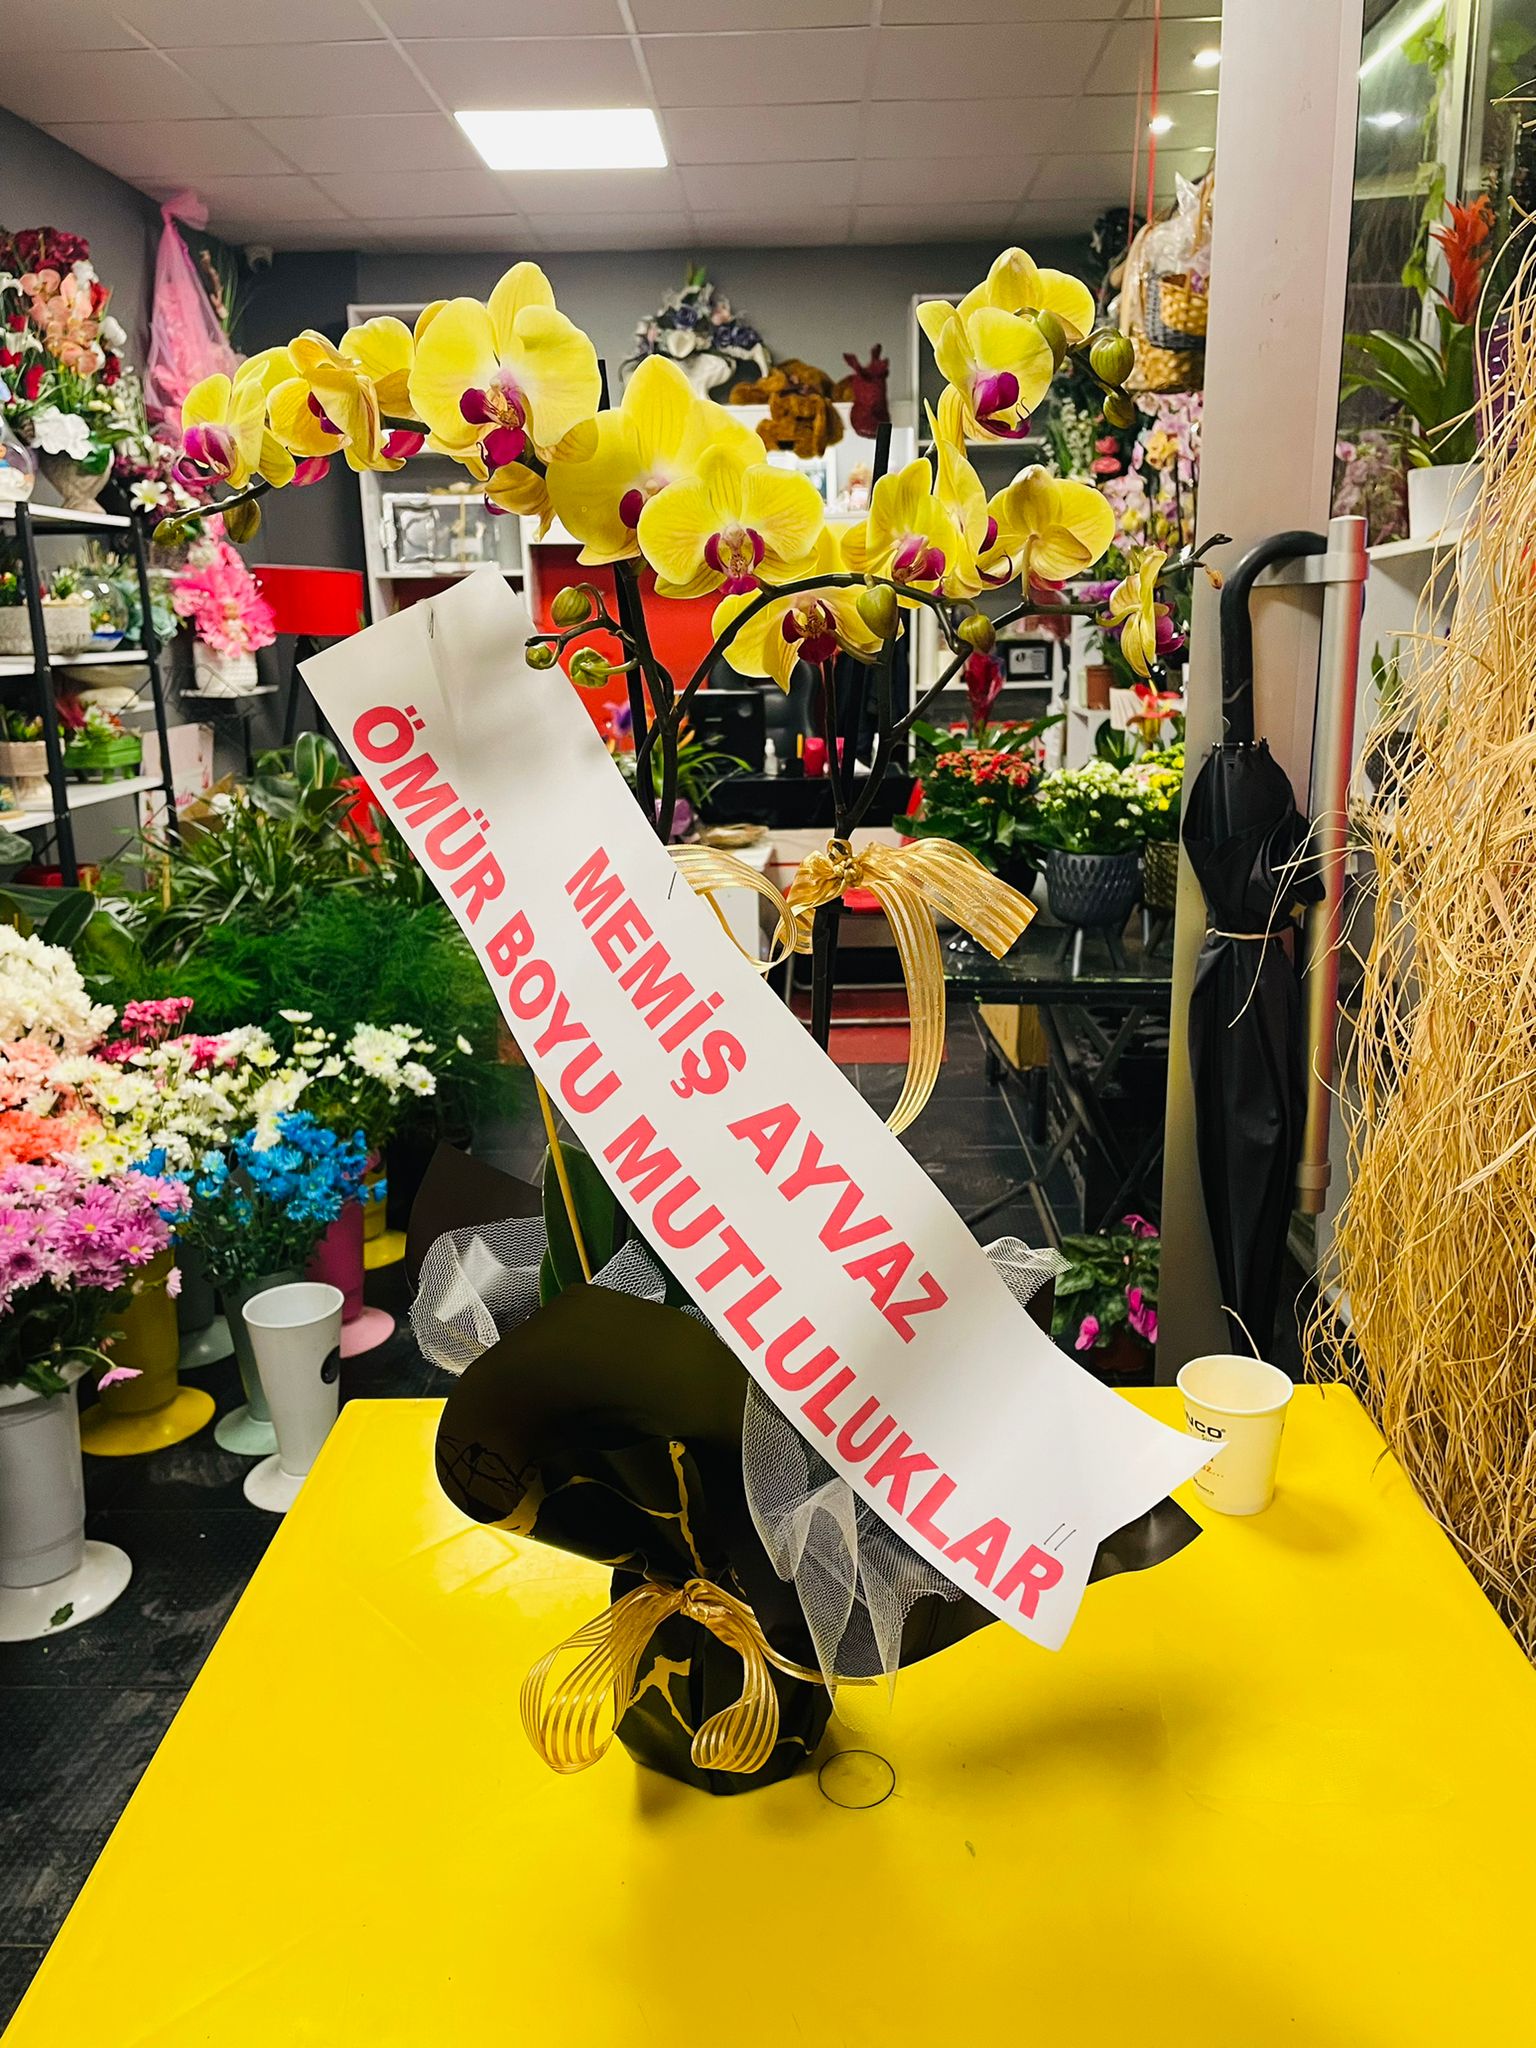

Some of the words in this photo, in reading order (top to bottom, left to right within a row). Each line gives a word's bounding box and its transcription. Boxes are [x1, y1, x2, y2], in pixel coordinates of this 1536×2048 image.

[352, 704, 507, 925] ÖMÜR
[485, 909, 623, 1114] BOYU
[602, 1113, 1065, 1620] MUTLULUKLAR
[564, 846, 747, 1099] MEMİŞ
[726, 1102, 950, 1344] AYVAZ
